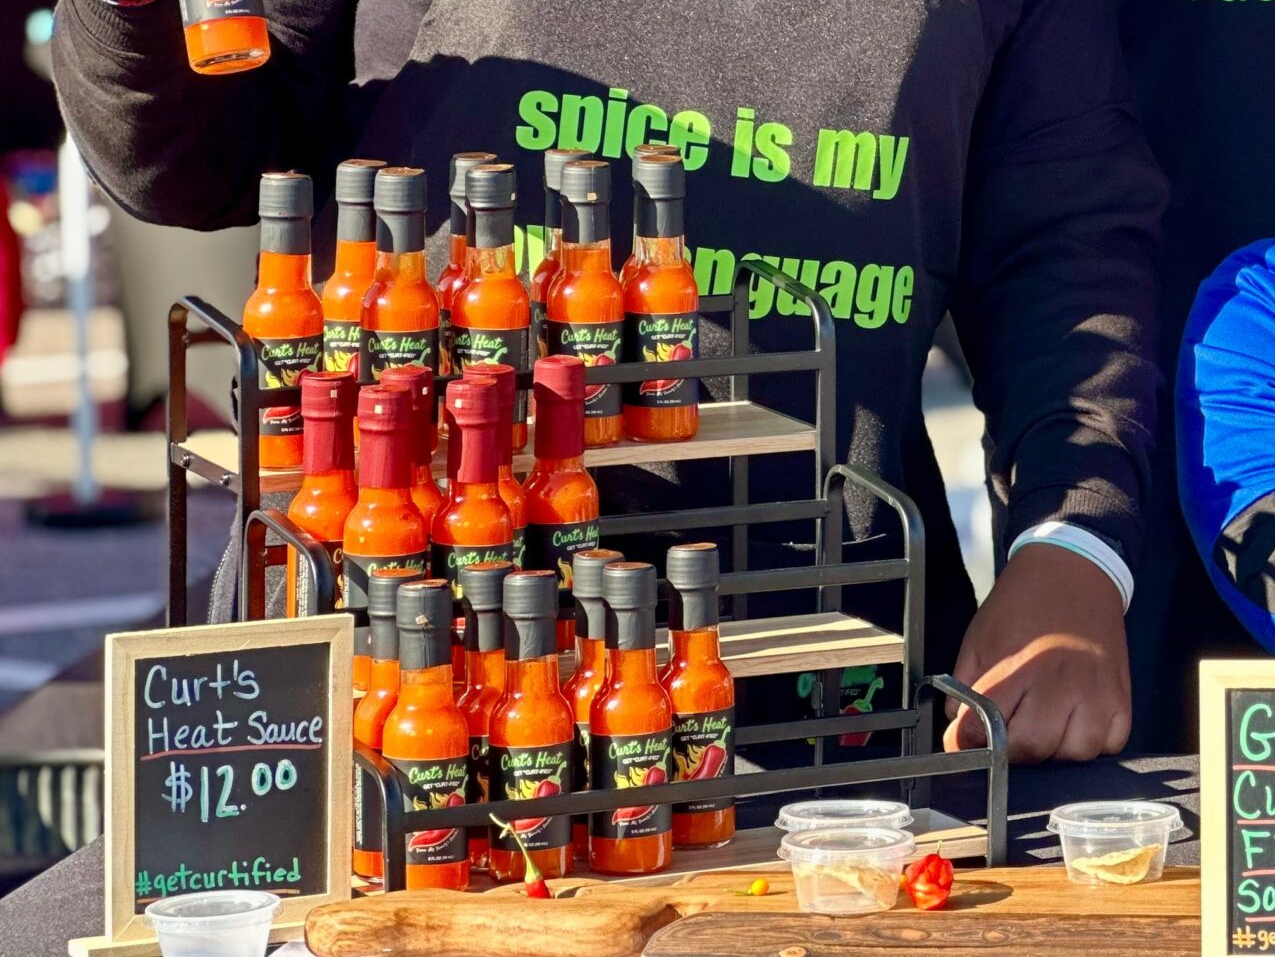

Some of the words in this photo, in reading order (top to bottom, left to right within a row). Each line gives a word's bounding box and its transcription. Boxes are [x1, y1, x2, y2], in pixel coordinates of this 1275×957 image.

[515, 88, 711, 172] spice
[730, 107, 792, 183] is
[813, 128, 910, 201] my
[686, 245, 914, 329] nguage
[561, 329, 591, 344] Curt's
[593, 328, 618, 343] Heat
[639, 318, 669, 335] Curt's
[671, 318, 694, 333] Heat
[261, 344, 294, 360] Curt's
[296, 342, 320, 358] Heat
[368, 337, 397, 353] Curt's
[400, 336, 426, 352] Heat
[473, 333, 503, 350] Heat
[552, 529, 584, 547] Curt's
[448, 551, 480, 568] Curt's
[144, 658, 260, 709] Curt's
[147, 710, 239, 755] Heat
[247, 710, 324, 745] Sauce
[702, 716, 728, 733] Heat
[608, 741, 642, 759] Curt's
[644, 738, 668, 755] Heat
[501, 753, 532, 771] Curt's
[535, 751, 563, 768] Heat
[408, 765, 443, 784] Curt's
[445, 764, 467, 780] Heat
[161, 758, 298, 823] $12.00
[135, 856, 302, 896] #getcurtified
